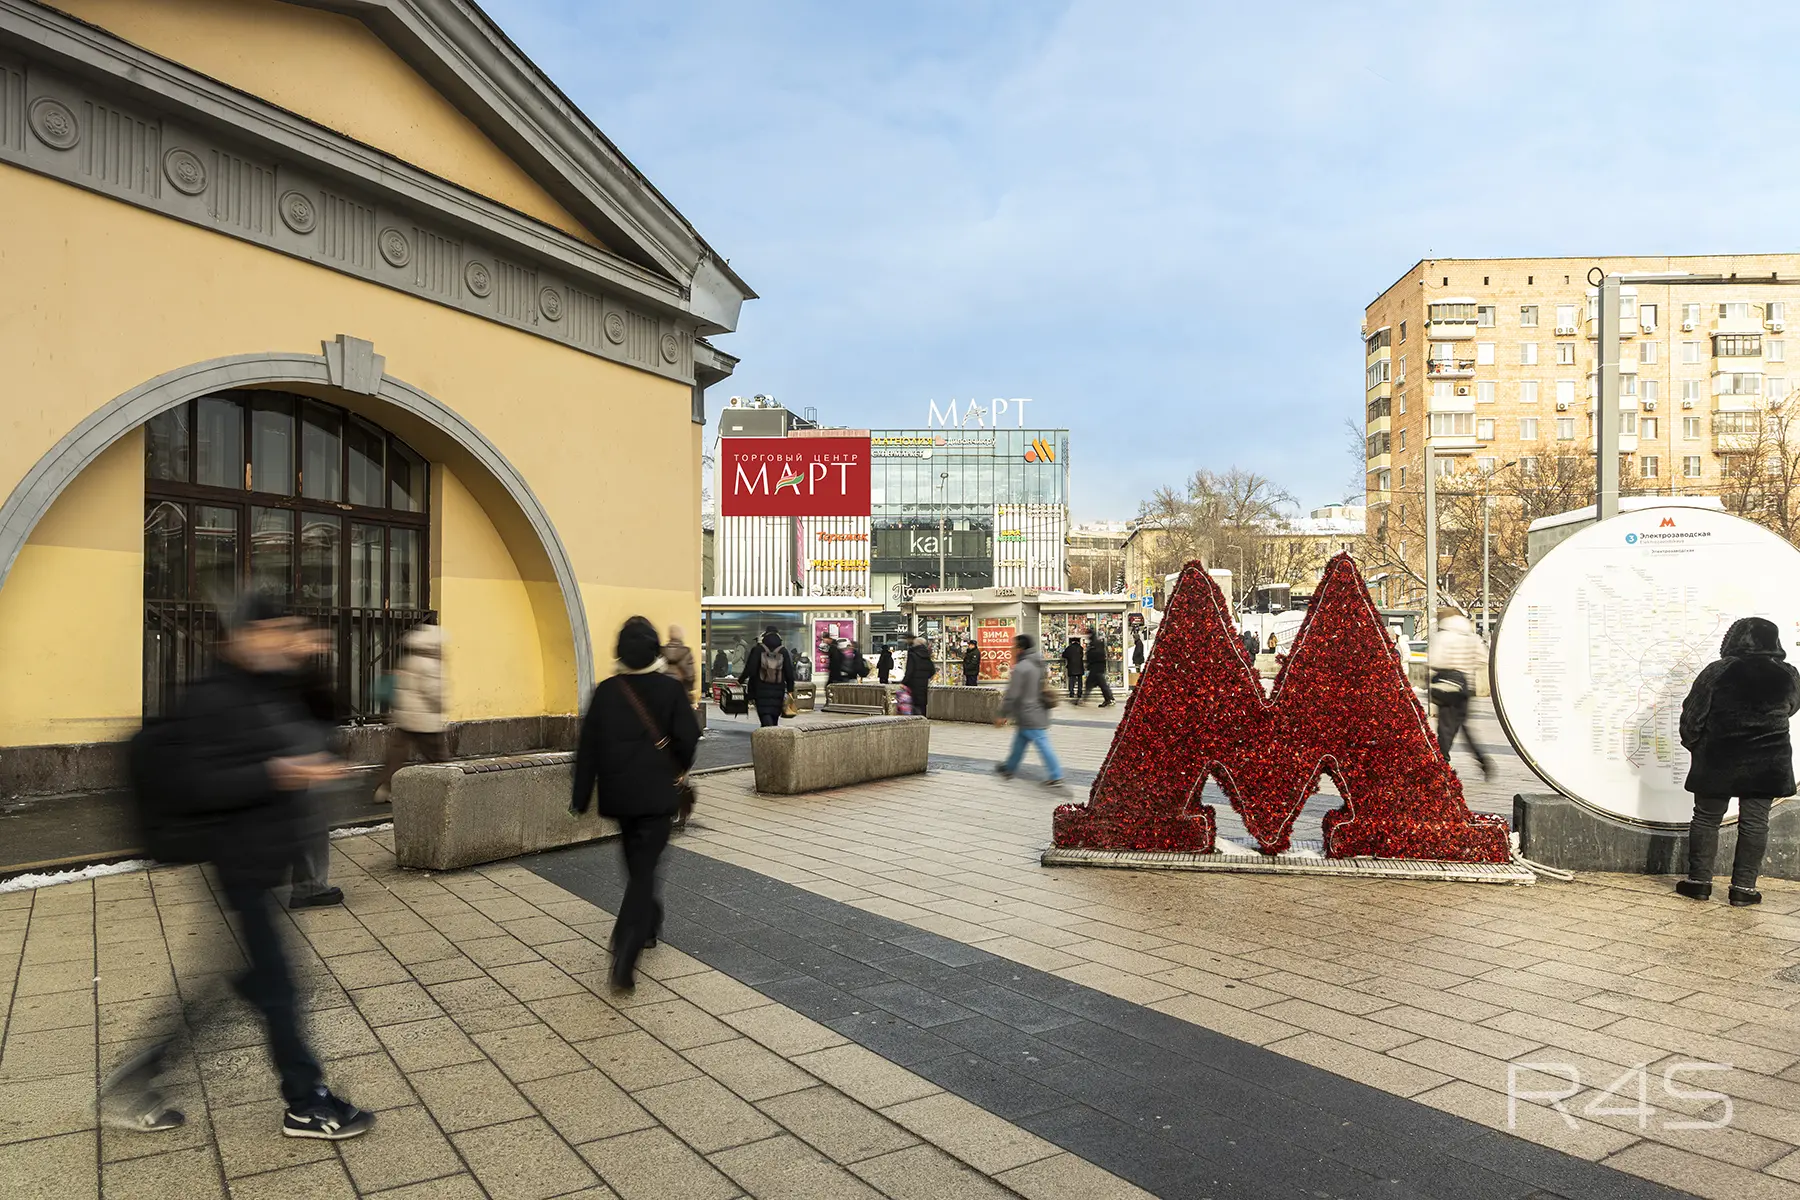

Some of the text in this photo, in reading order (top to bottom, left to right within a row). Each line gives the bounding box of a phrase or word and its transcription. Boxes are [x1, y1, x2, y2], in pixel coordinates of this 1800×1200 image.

[928, 398, 1033, 426] МАРТ
[734, 453, 858, 463] ТОРГОВЫЙ ЦЕНТР
[733, 462, 857, 495] МАРТ
[816, 531, 868, 543] Теремок
[911, 529, 953, 553] kari
[983, 631, 1009, 639] ЗИМА
[981, 650, 1012, 660] 2026
